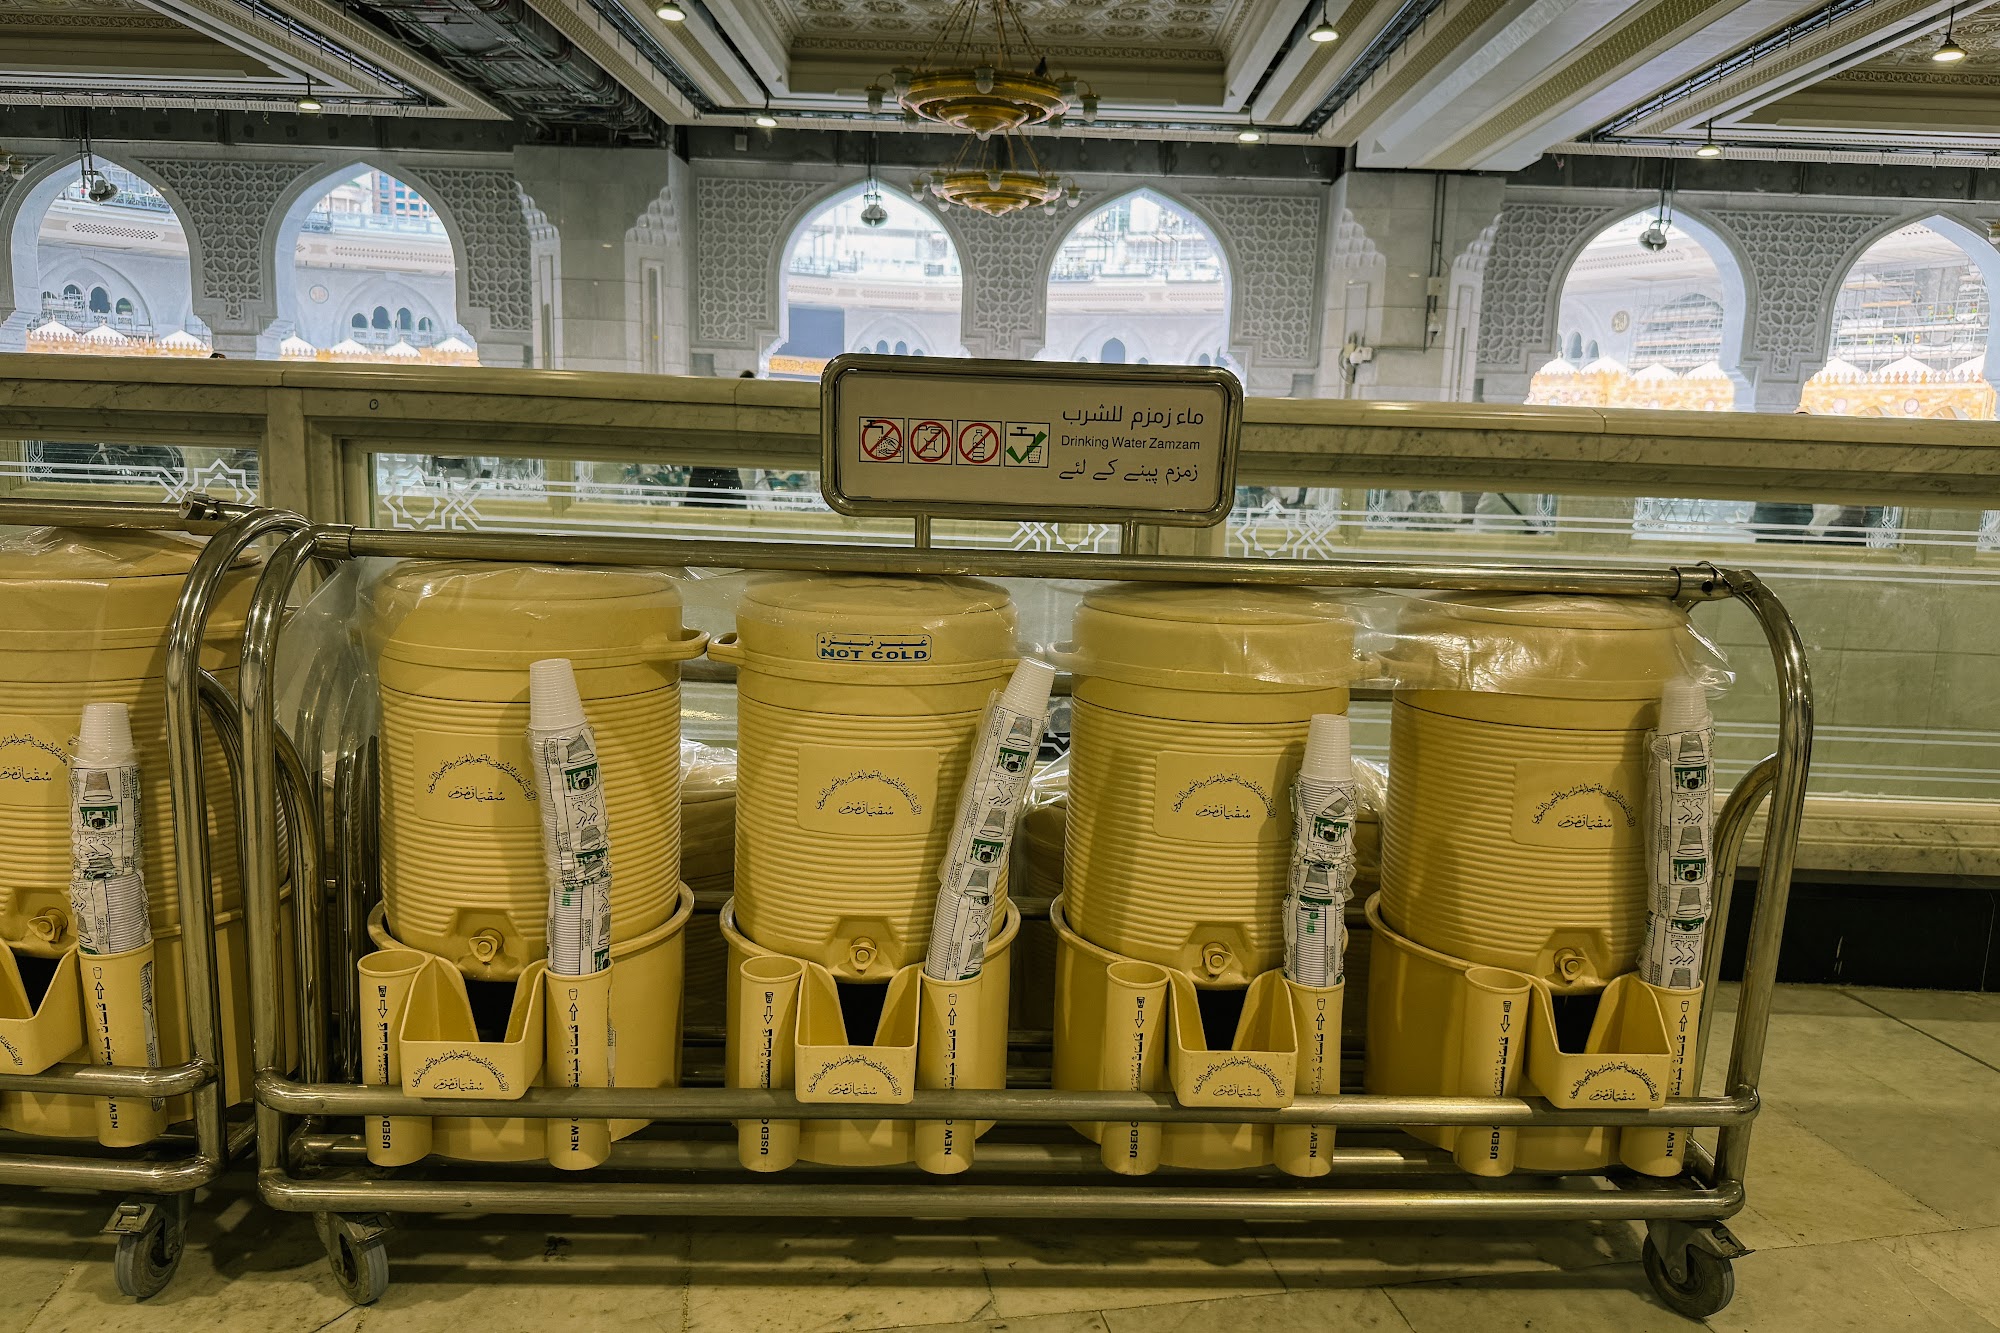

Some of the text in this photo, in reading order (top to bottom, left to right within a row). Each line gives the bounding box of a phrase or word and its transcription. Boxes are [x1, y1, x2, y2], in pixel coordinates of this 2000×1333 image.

[1062, 403, 1204, 430] ماء زمزم للشرب
[1061, 434, 1200, 450] Drinking Water Zamzam
[1092, 458, 1118, 480] کے
[1165, 464, 1198, 486] زمزم
[821, 648, 928, 660] NOT COLD
[877, 636, 928, 650] غير
[108, 1102, 118, 1128] NEW
[382, 1121, 390, 1148] USED
[571, 1125, 579, 1151] NEW
[760, 1126, 768, 1154] USED
[944, 1129, 952, 1155] NEW
[1130, 1130, 1138, 1158] USED
[1310, 1132, 1318, 1158] NEW
[1490, 1132, 1500, 1160] USED
[1666, 1132, 1674, 1156] NEW
